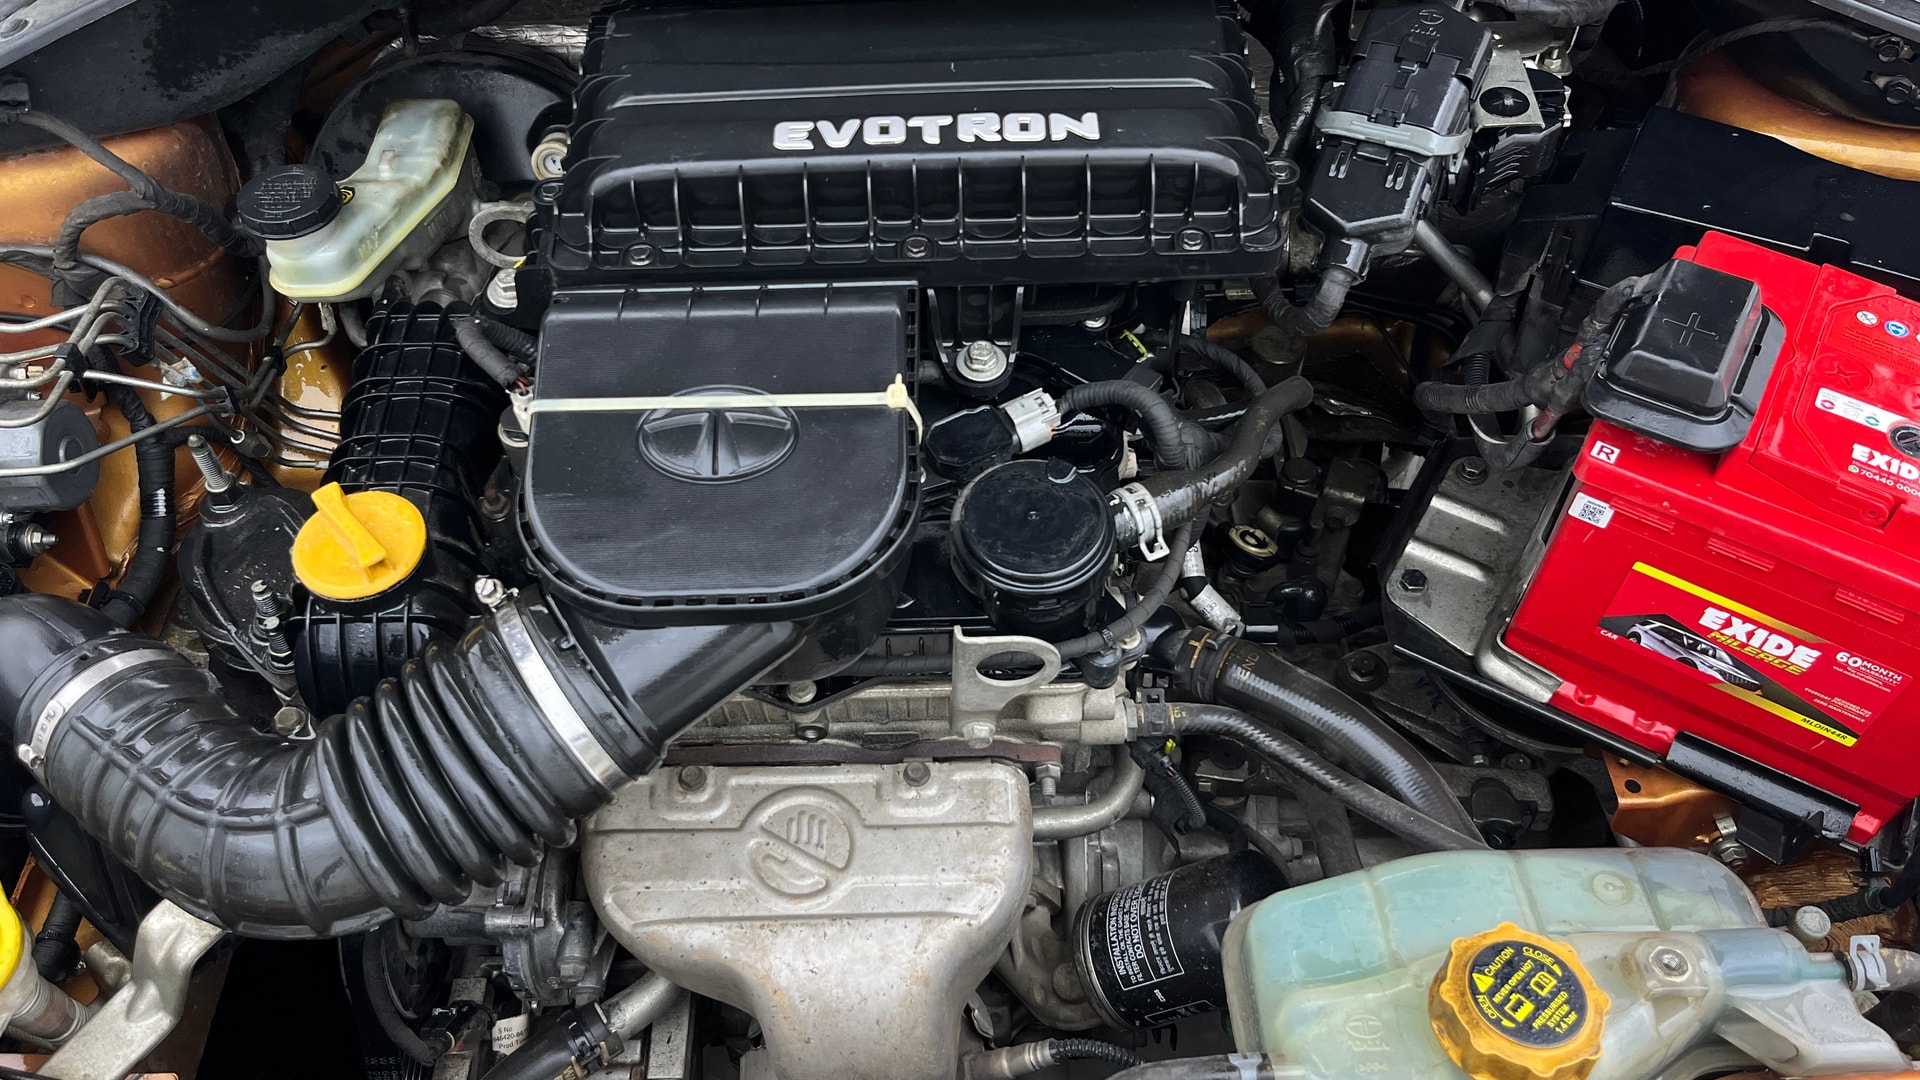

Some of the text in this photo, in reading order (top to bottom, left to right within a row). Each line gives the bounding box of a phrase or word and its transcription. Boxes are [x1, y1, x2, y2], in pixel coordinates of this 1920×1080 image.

[773, 111, 1100, 150] EVOTRON
[1596, 444, 1615, 461] R
[1851, 443, 1920, 484] EXID
[1860, 469, 1894, 487] 70440
[1600, 629, 1618, 640] CAR
[1698, 606, 1823, 669] EXIDE
[1707, 631, 1808, 676] MILEAGE
[1835, 651, 1903, 682] 60 MONTH
[1801, 717, 1848, 740] MLDIN44R
[1109, 916, 1127, 975] INSTALLATION
[1124, 928, 1136, 961] CONTACTS
[1130, 923, 1140, 943] NOT
[1134, 943, 1144, 959] DO
[1484, 946, 1515, 976] CAUTION
[1522, 946, 1555, 964] CLOSE
[1132, 960, 1144, 982] FILTER
[1492, 959, 1534, 1004] NEVER OPEN HOT
[1475, 994, 1497, 1019] OPEN
[1532, 991, 1568, 1030] PRESSURISED
[1546, 1003, 1570, 1028] SYSTEM
